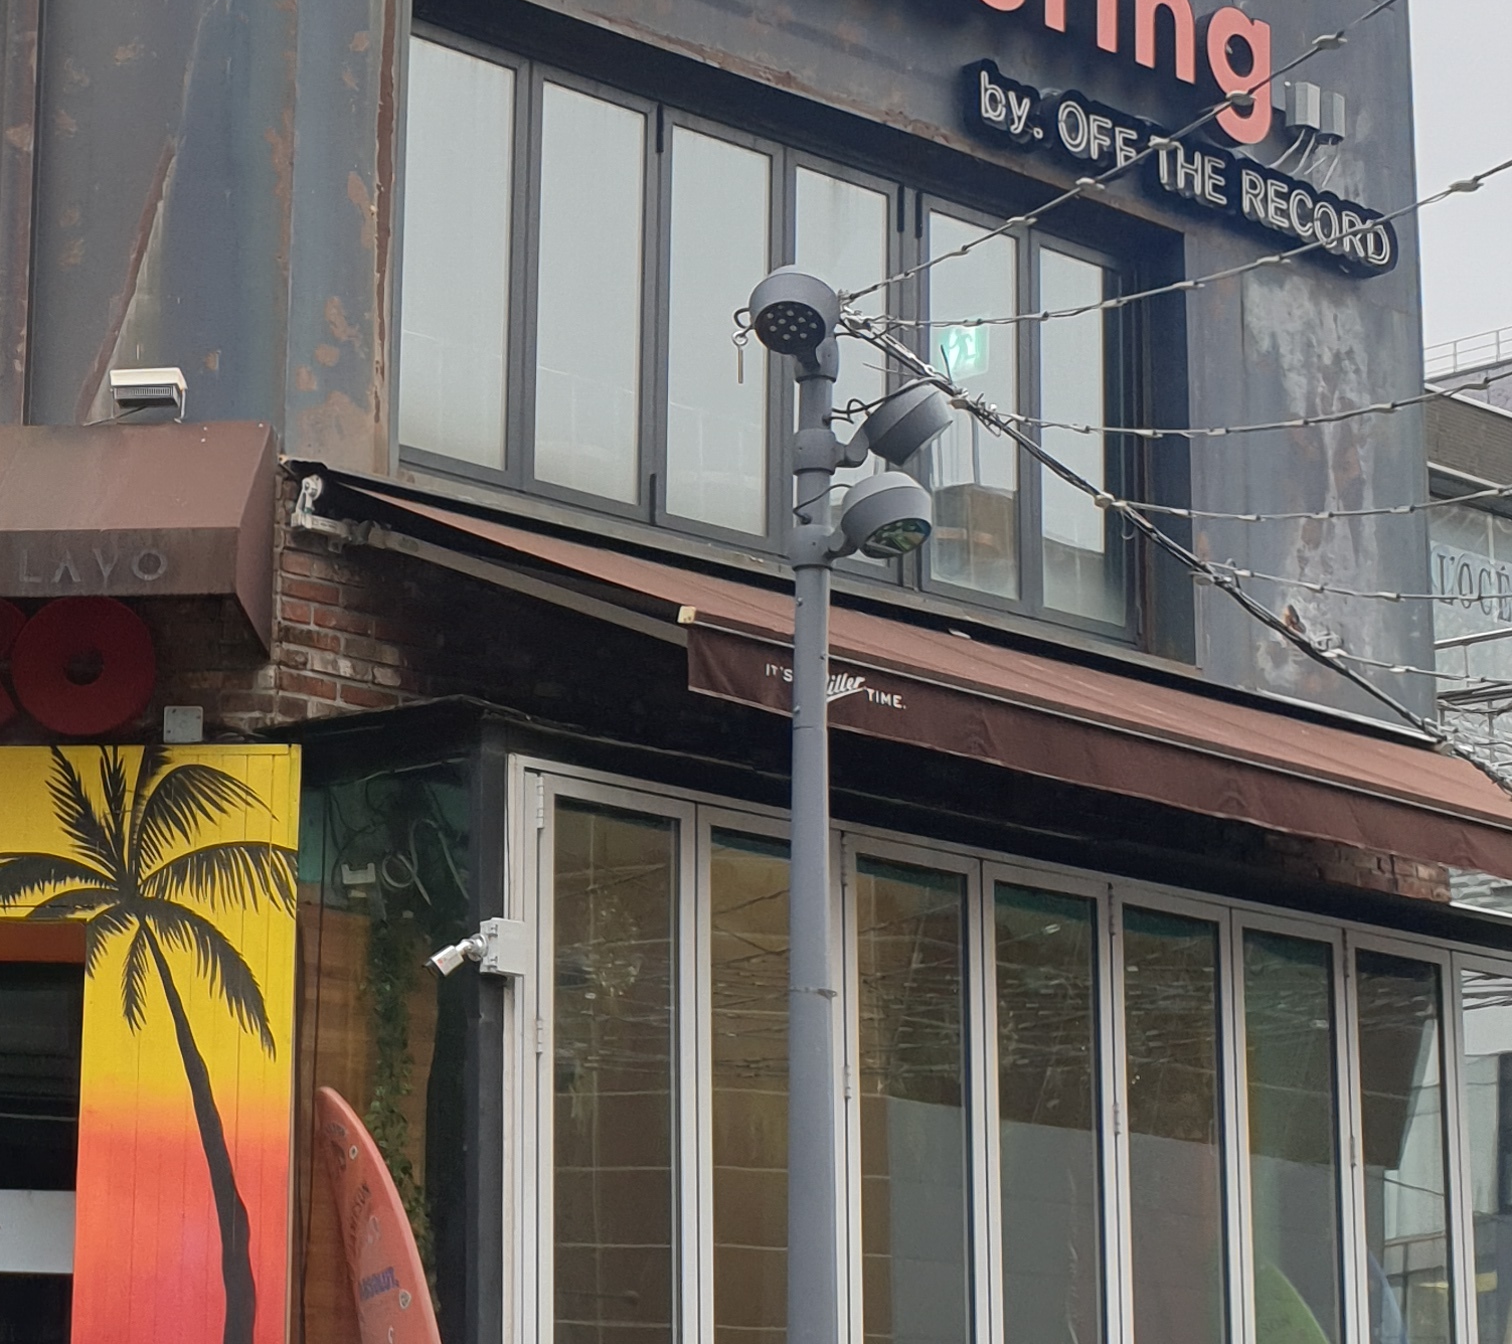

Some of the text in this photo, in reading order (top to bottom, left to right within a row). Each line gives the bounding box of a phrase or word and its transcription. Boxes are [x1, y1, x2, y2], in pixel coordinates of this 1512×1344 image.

[1057, 95, 1138, 168] OFF
[1154, 134, 1227, 205] THE
[1242, 165, 1392, 266] RECORD
[765, 662, 794, 683] IT'S
[826, 672, 866, 703] iller
